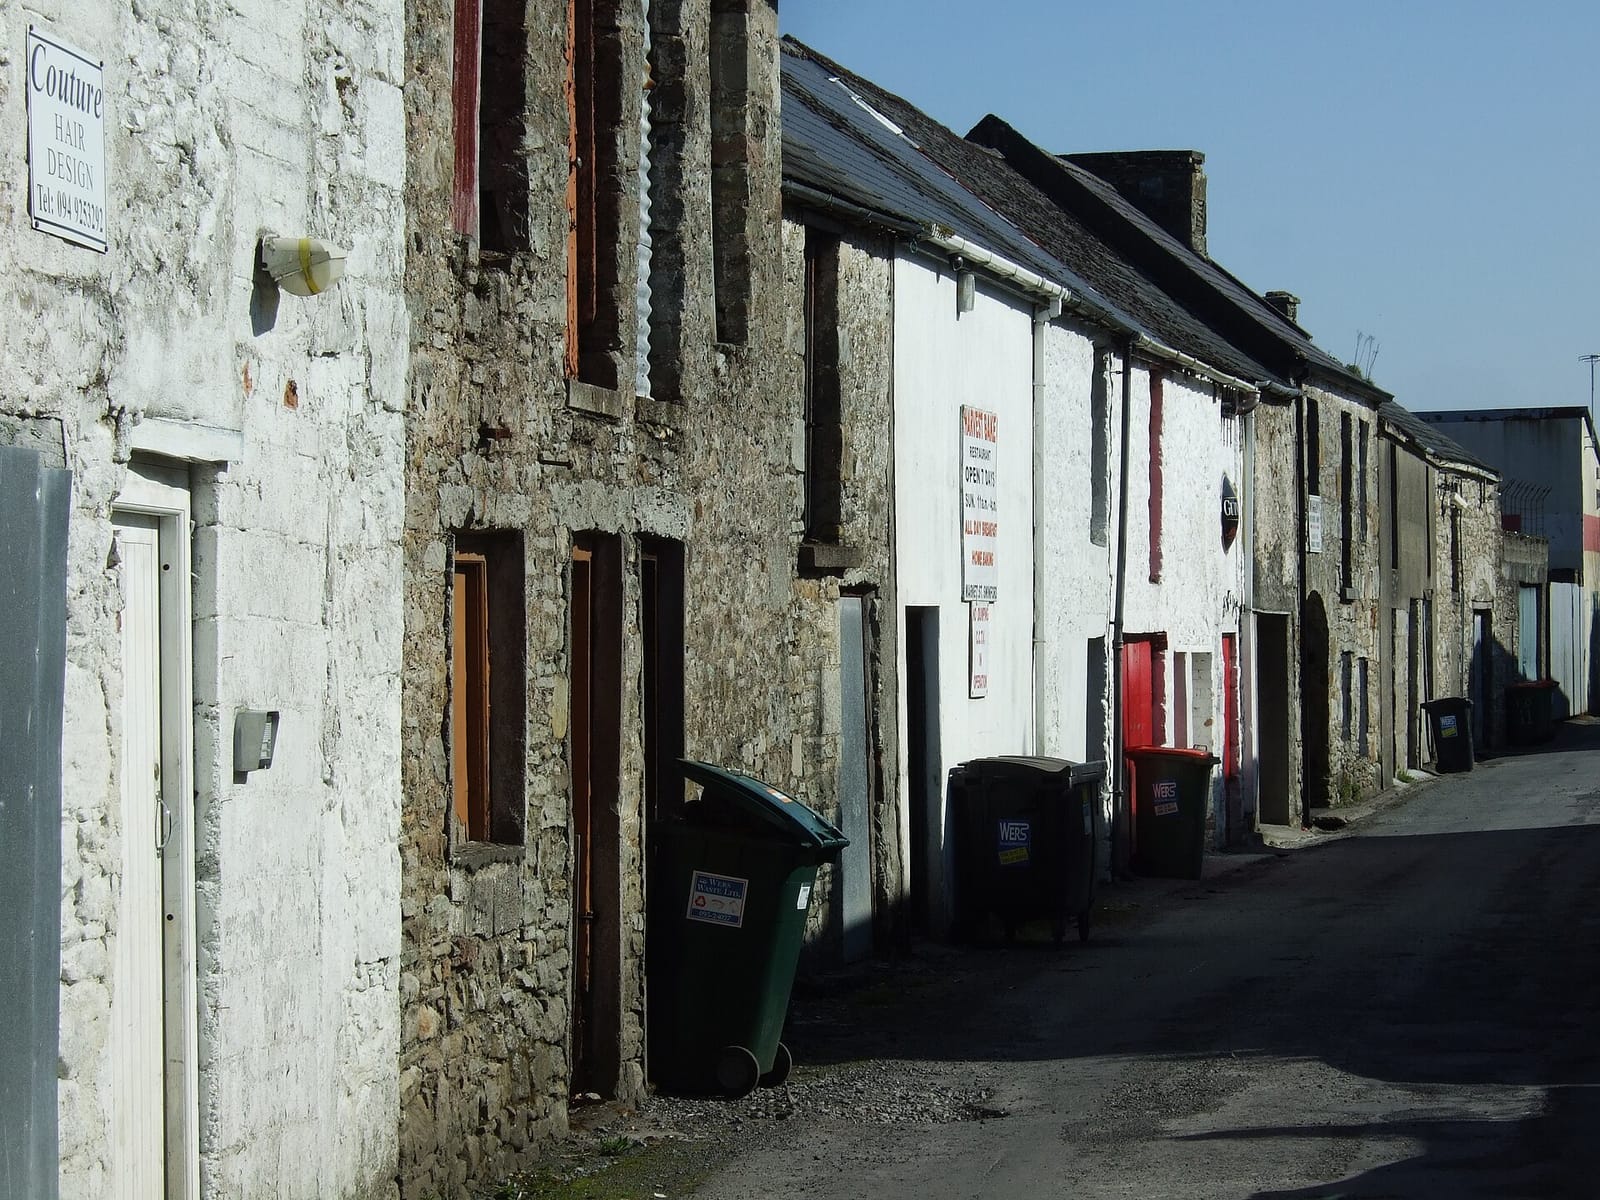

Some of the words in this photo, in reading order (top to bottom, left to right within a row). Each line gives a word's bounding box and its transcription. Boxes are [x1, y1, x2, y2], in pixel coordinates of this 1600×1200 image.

[31, 43, 102, 119] Couture
[54, 113, 86, 152] HAIR
[47, 147, 94, 191] DESIGN
[37, 183, 54, 215] Tel:
[57, 189, 72, 221] 094
[965, 465, 980, 484] OPEN
[985, 469, 995, 488] DAYS
[965, 519, 973, 535] ALL
[973, 520, 981, 536] DAY
[1152, 782, 1177, 799] WERS
[999, 822, 1029, 841] WERS
